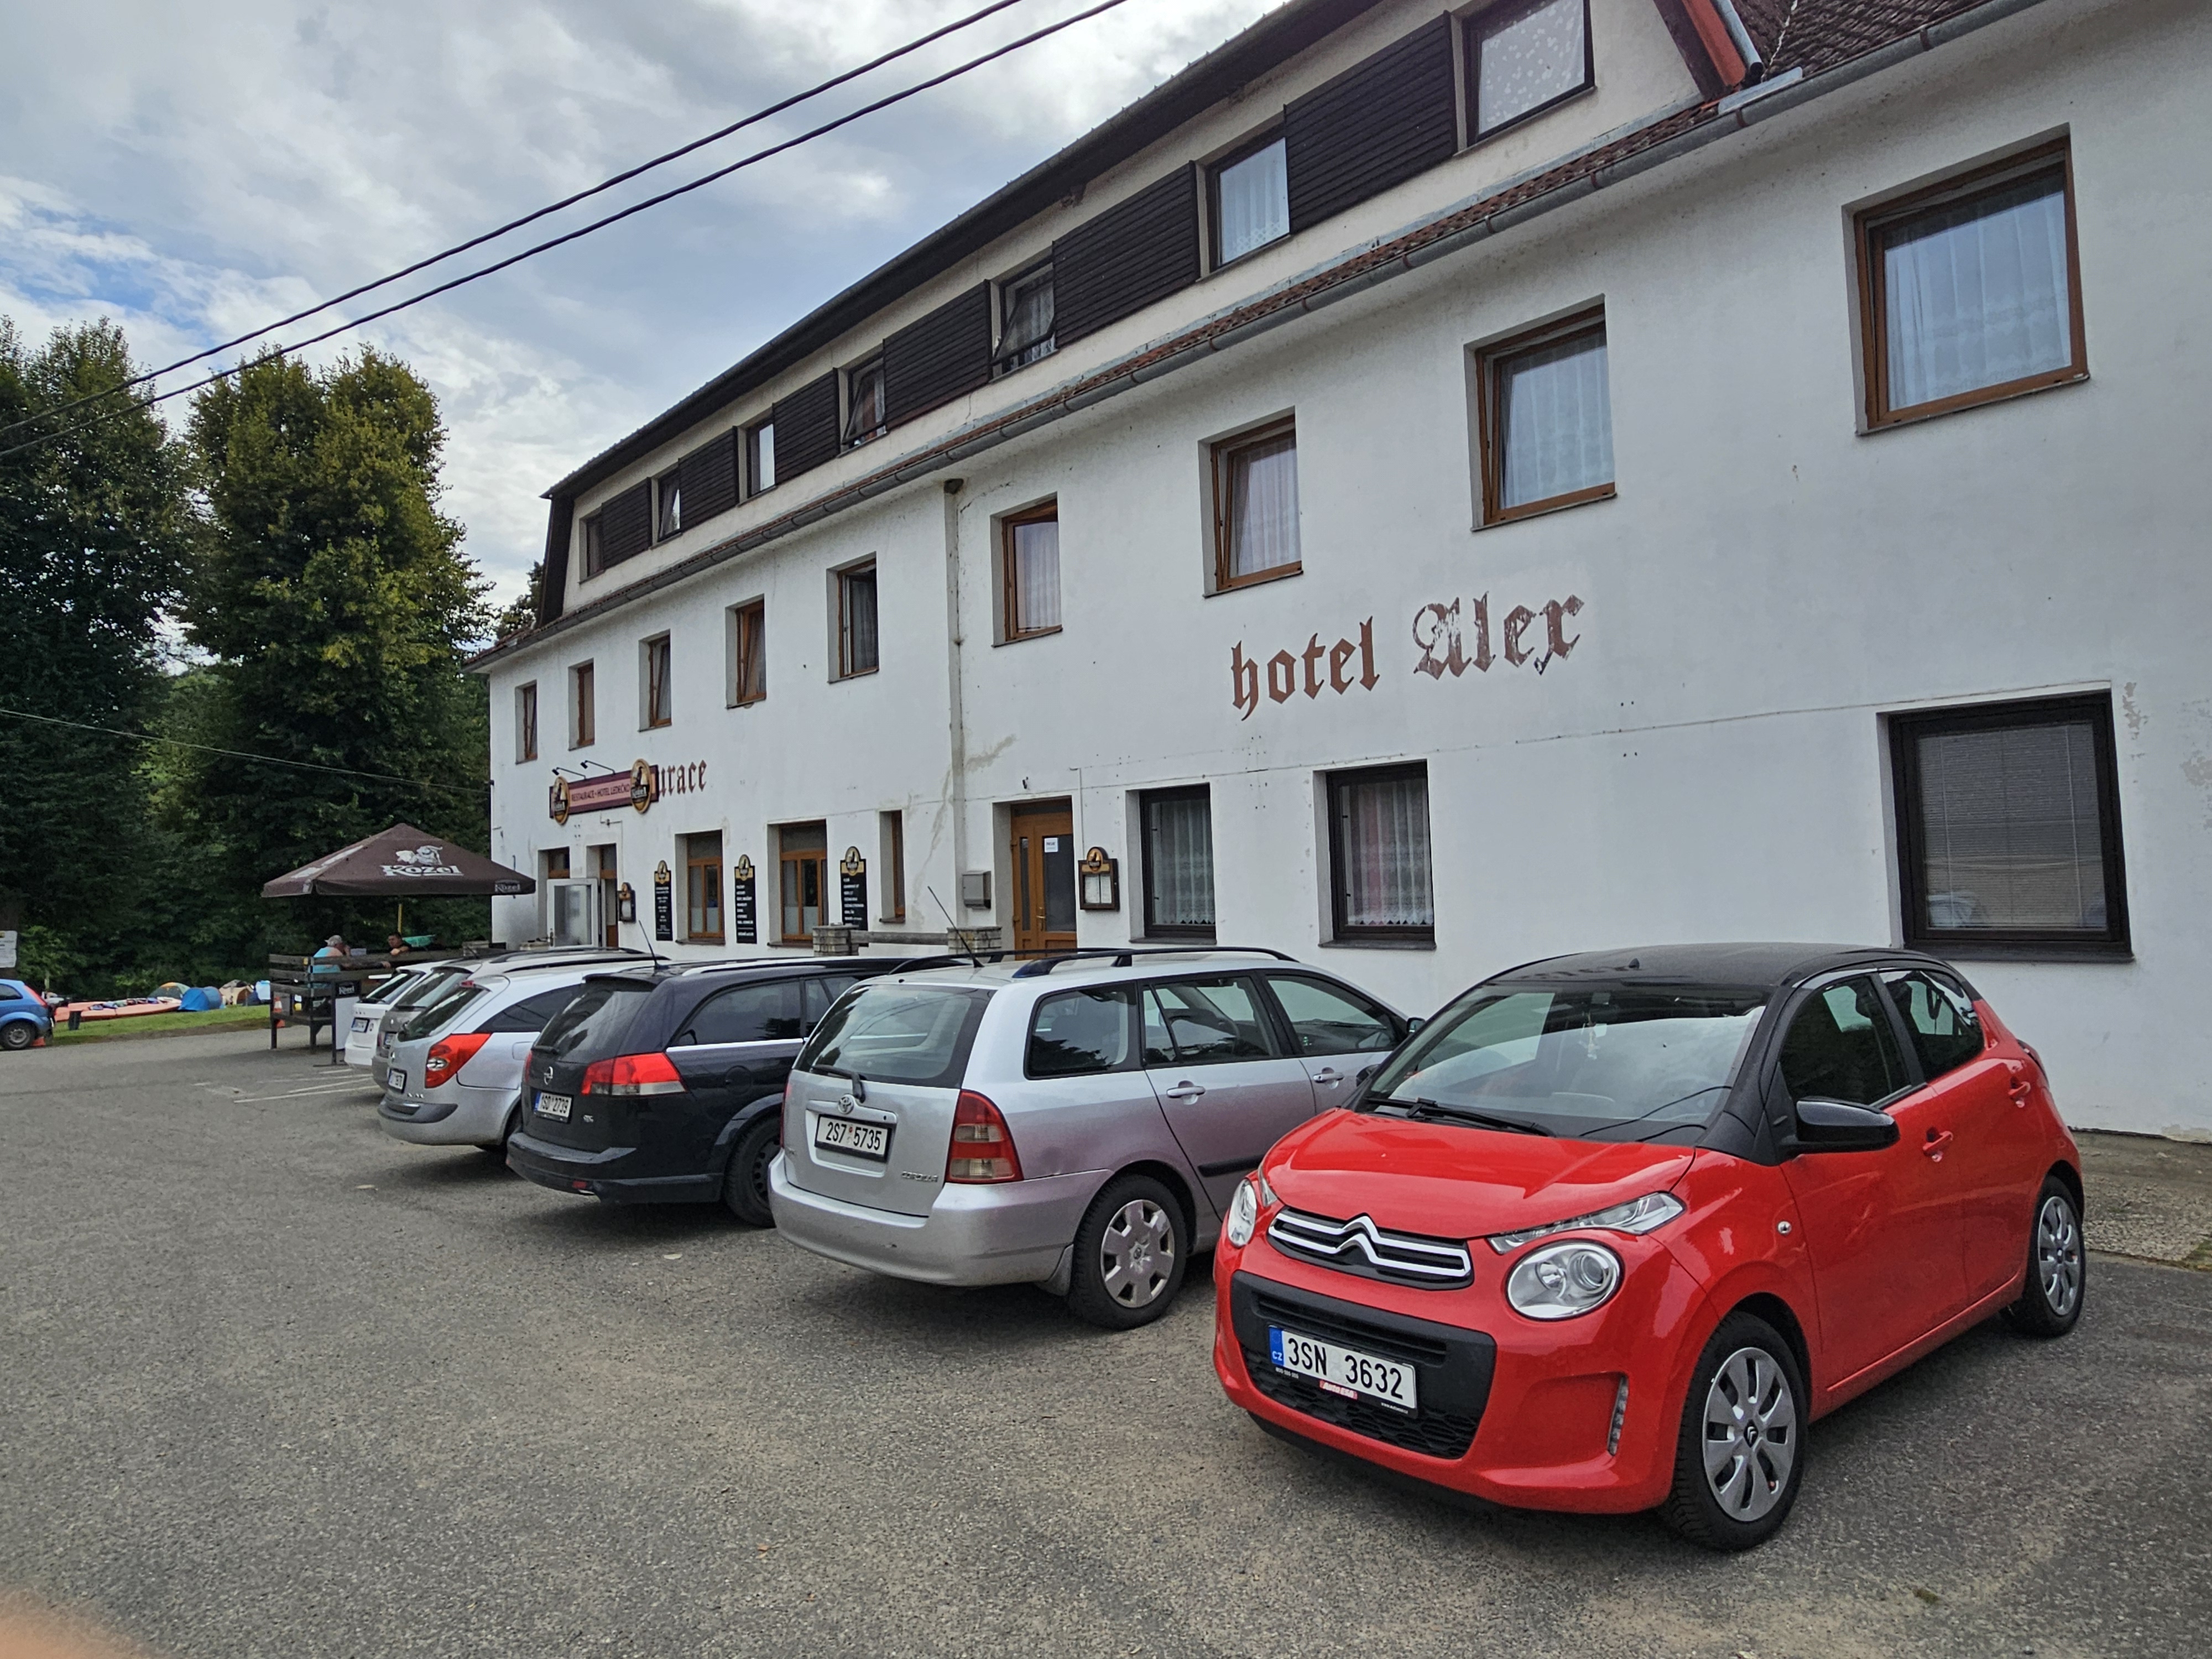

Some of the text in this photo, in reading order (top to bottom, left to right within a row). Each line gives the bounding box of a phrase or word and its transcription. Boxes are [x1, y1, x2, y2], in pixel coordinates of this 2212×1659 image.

[1231, 615, 1380, 721] hotel
[597, 787, 610, 797] HOTEL
[380, 864, 465, 877] Kozel
[495, 884, 520, 893] Kozel
[826, 1121, 882, 1151] 2S7 5735
[1272, 1350, 1283, 1361] CZ
[1288, 1338, 1404, 1400] 3SN 3632
